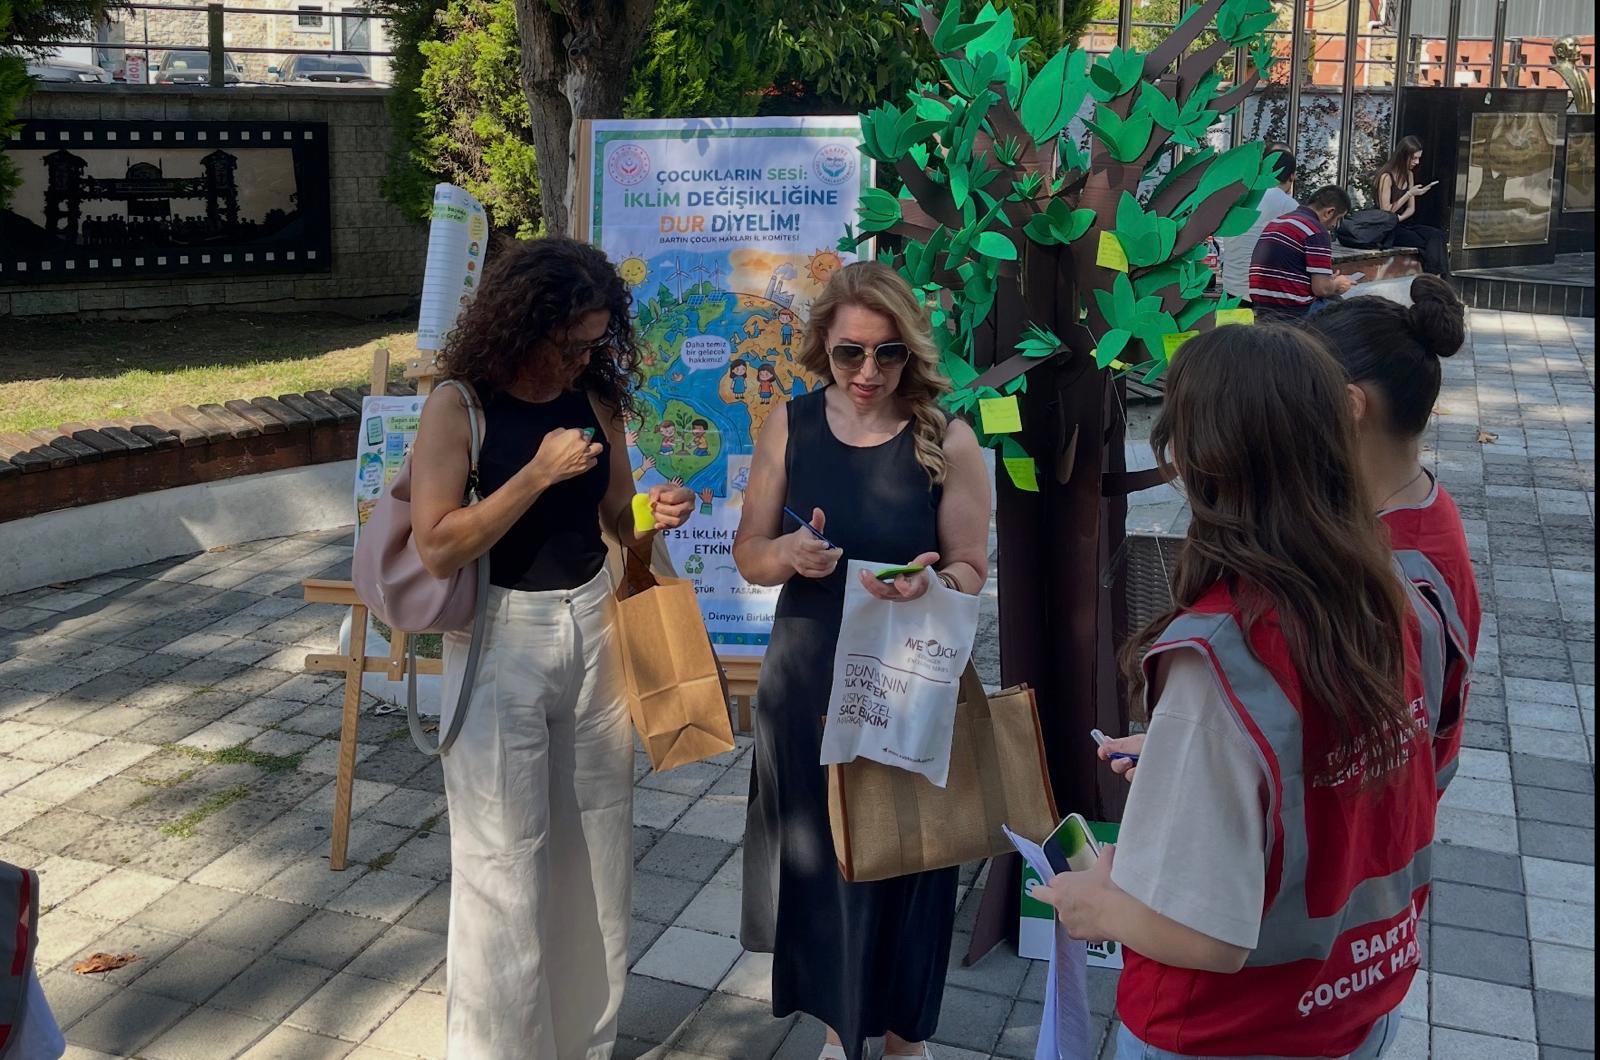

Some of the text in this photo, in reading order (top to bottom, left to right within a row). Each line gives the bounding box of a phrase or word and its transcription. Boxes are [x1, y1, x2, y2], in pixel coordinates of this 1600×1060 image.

[656, 165, 808, 185] ÇOCUKLARIN SESİ:
[624, 184, 838, 209] İKLİM DEĞİŞİKLİĞİNE
[659, 209, 800, 233] DUR DİYELİM!
[659, 236, 688, 244] BARTIN
[690, 236, 717, 245] ÇOCUK
[674, 529, 690, 539] 31
[692, 527, 728, 540] İKLİM
[694, 542, 731, 555] ETKİN
[1297, 959, 1385, 1018] ÇOCUK
